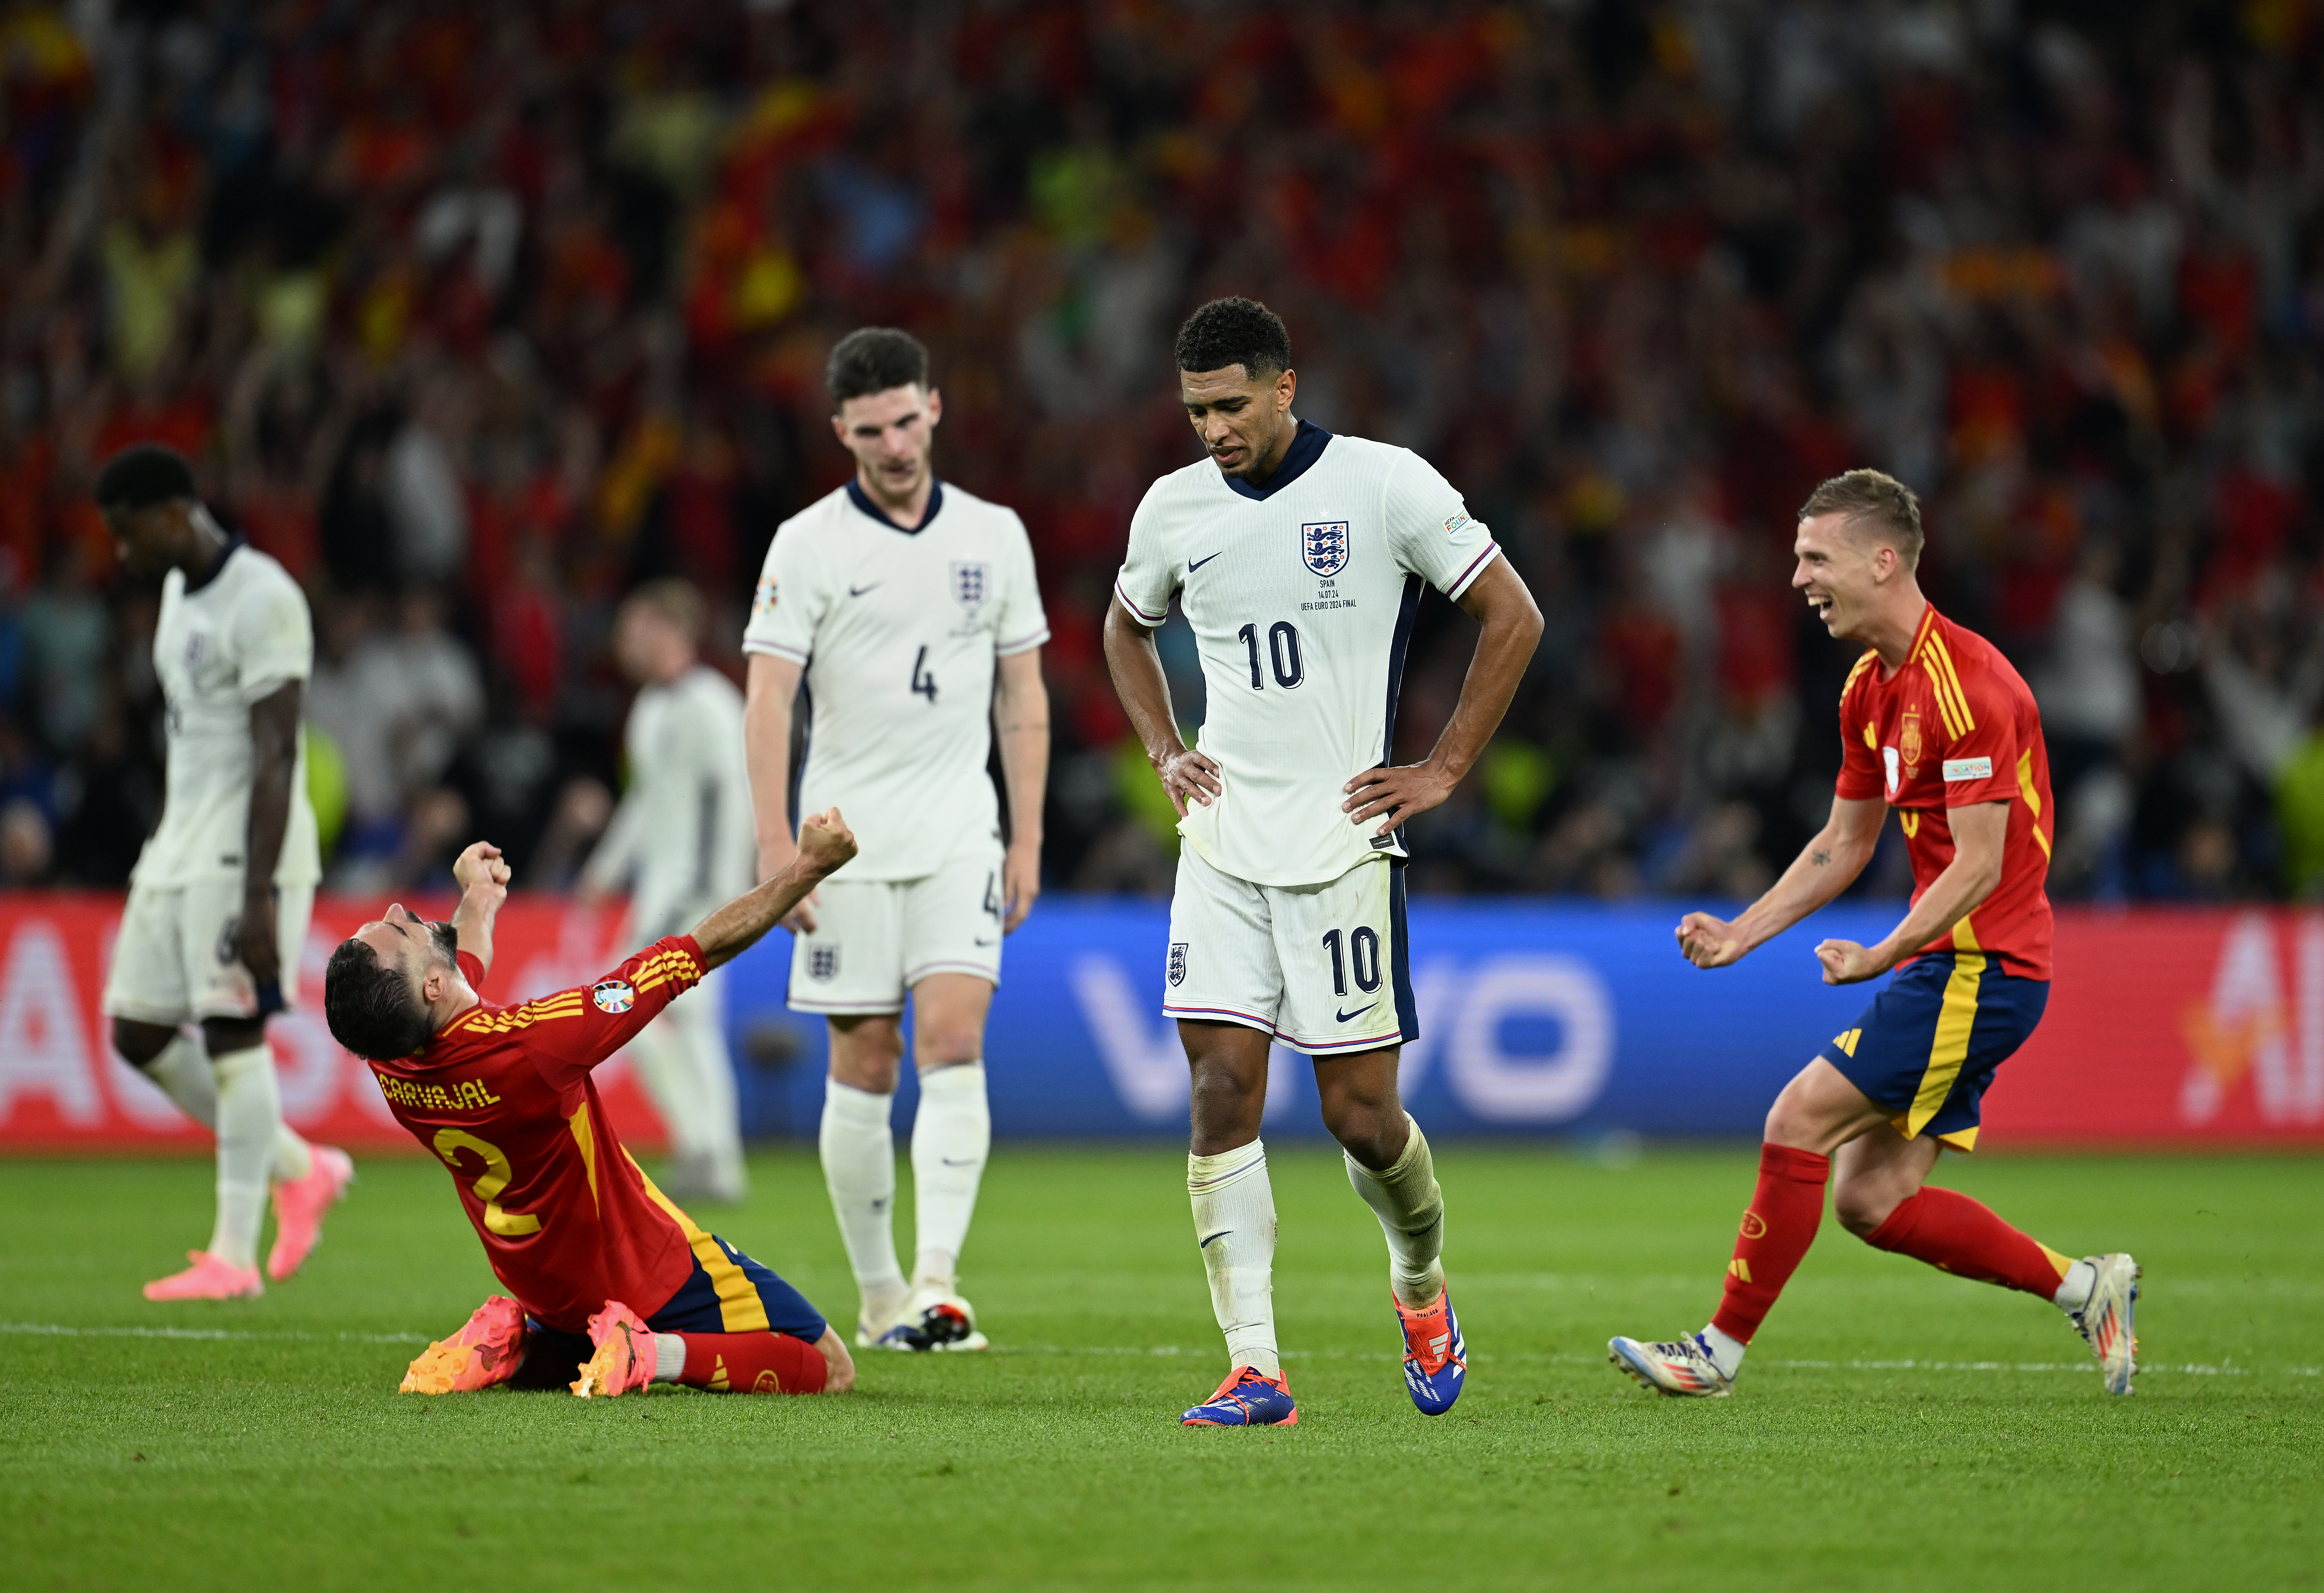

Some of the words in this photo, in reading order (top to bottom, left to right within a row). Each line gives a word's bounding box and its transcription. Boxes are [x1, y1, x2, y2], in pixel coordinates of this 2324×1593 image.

[1444, 516, 1455, 526] UEFA
[1447, 510, 1468, 532] FOUND
[1318, 590, 1338, 599] 14.07.24
[1320, 579, 1335, 588] SPAIN
[1315, 601, 1328, 610] EURO
[1329, 600, 1341, 609] 2024
[1343, 599, 1356, 608] FINAL
[1238, 621, 1305, 690] 10
[911, 645, 938, 702] 4
[983, 871, 1002, 924] 4
[1322, 926, 1383, 996] 10
[379, 1073, 501, 1110] CARVAJAL
[433, 1127, 542, 1236] 2
[1455, 1358, 1467, 1370] ATOR
